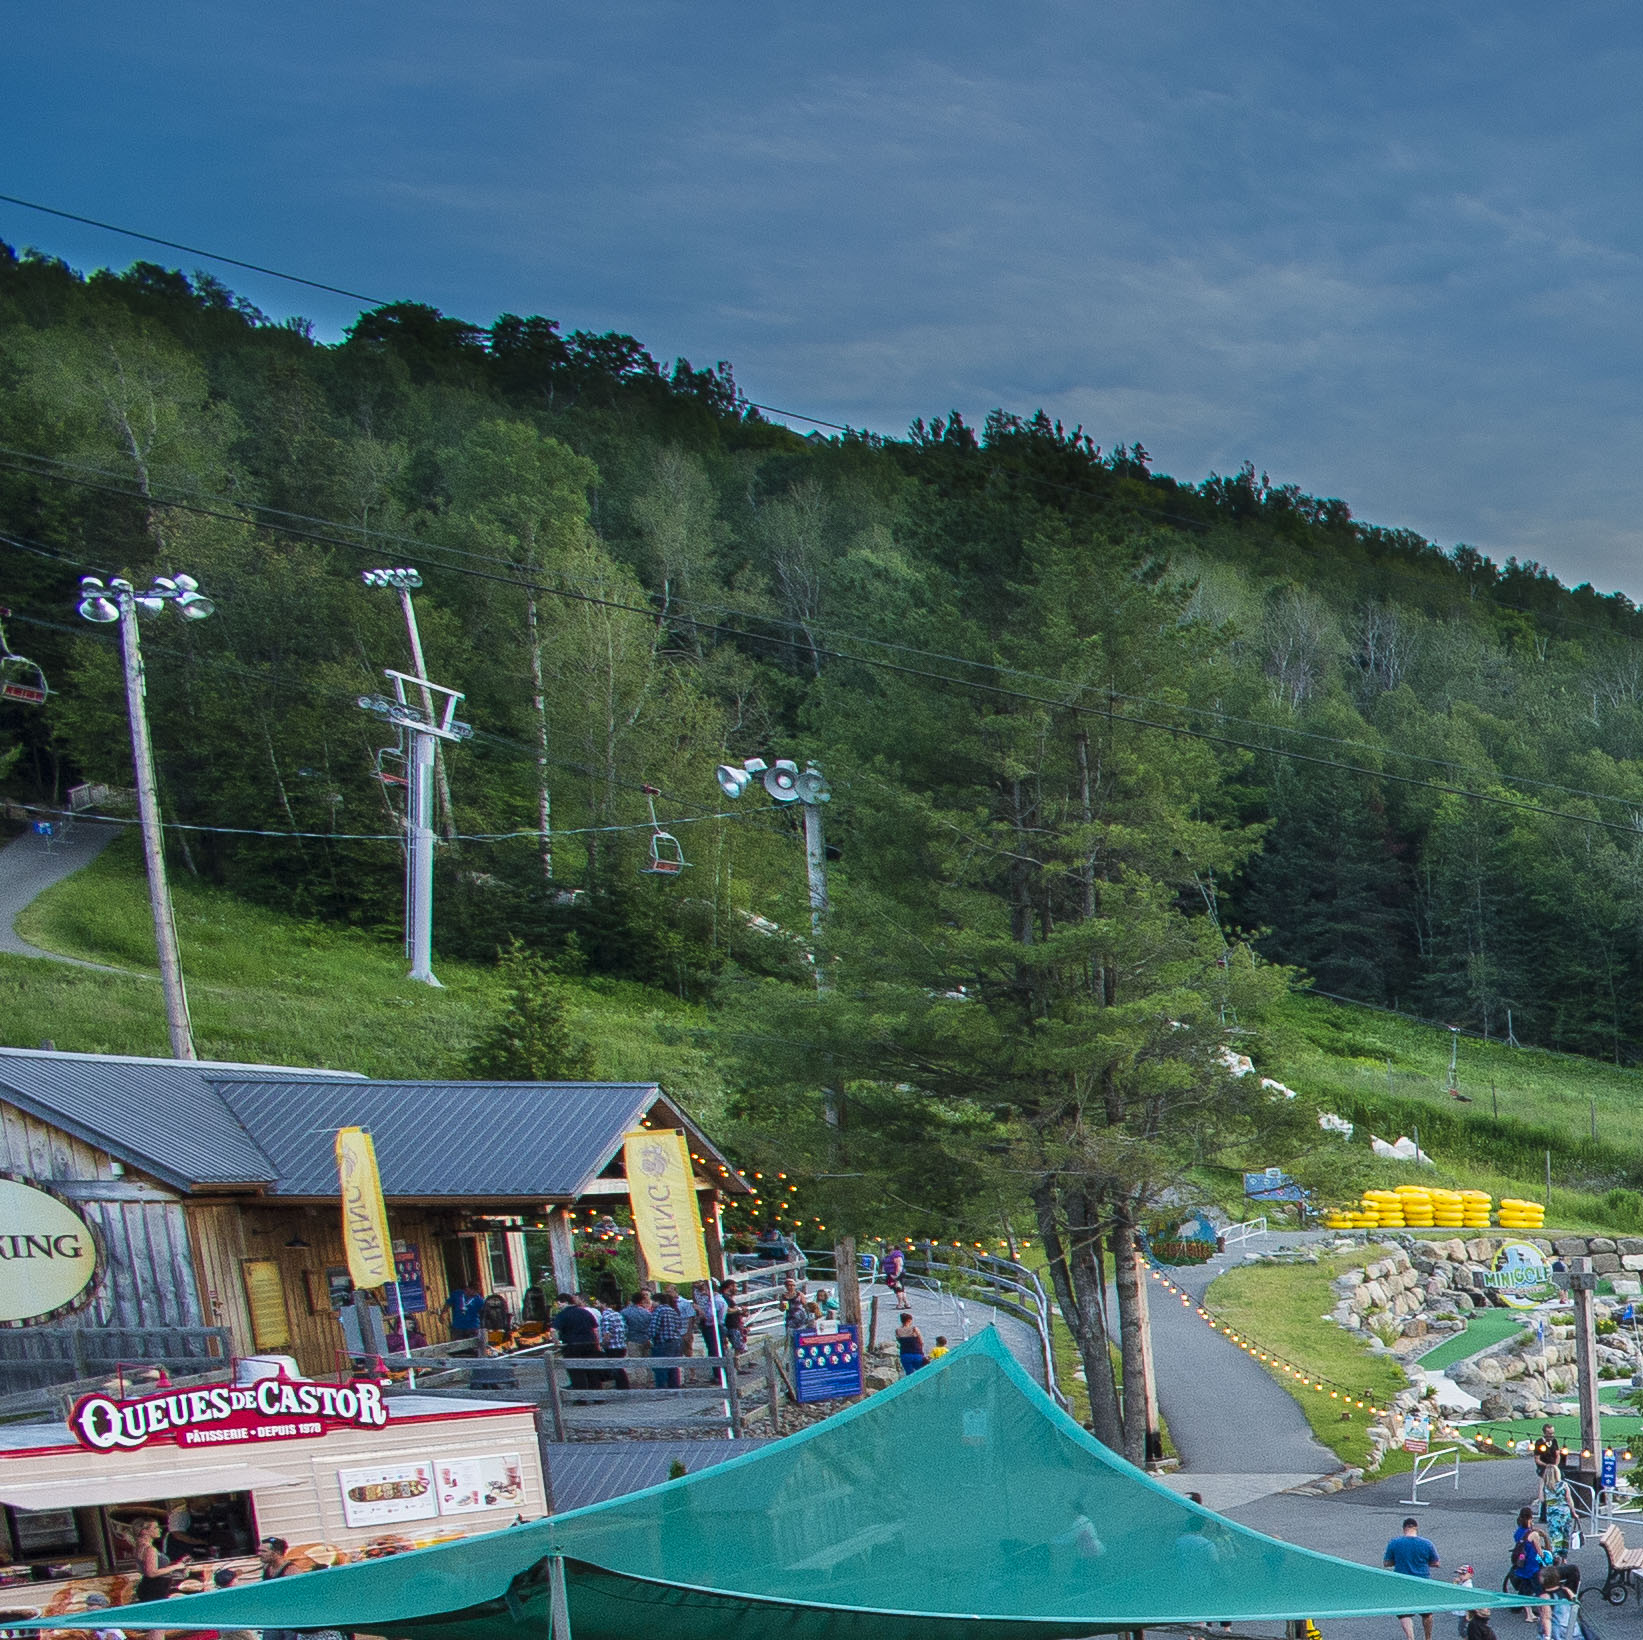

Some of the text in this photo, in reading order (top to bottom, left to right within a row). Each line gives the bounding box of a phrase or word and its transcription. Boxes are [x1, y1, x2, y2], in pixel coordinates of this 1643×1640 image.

[79, 1381, 387, 1448] QUEUES DE CASTOR
[185, 1422, 322, 1444] PÂTISSERIE DEPUIS 1978
